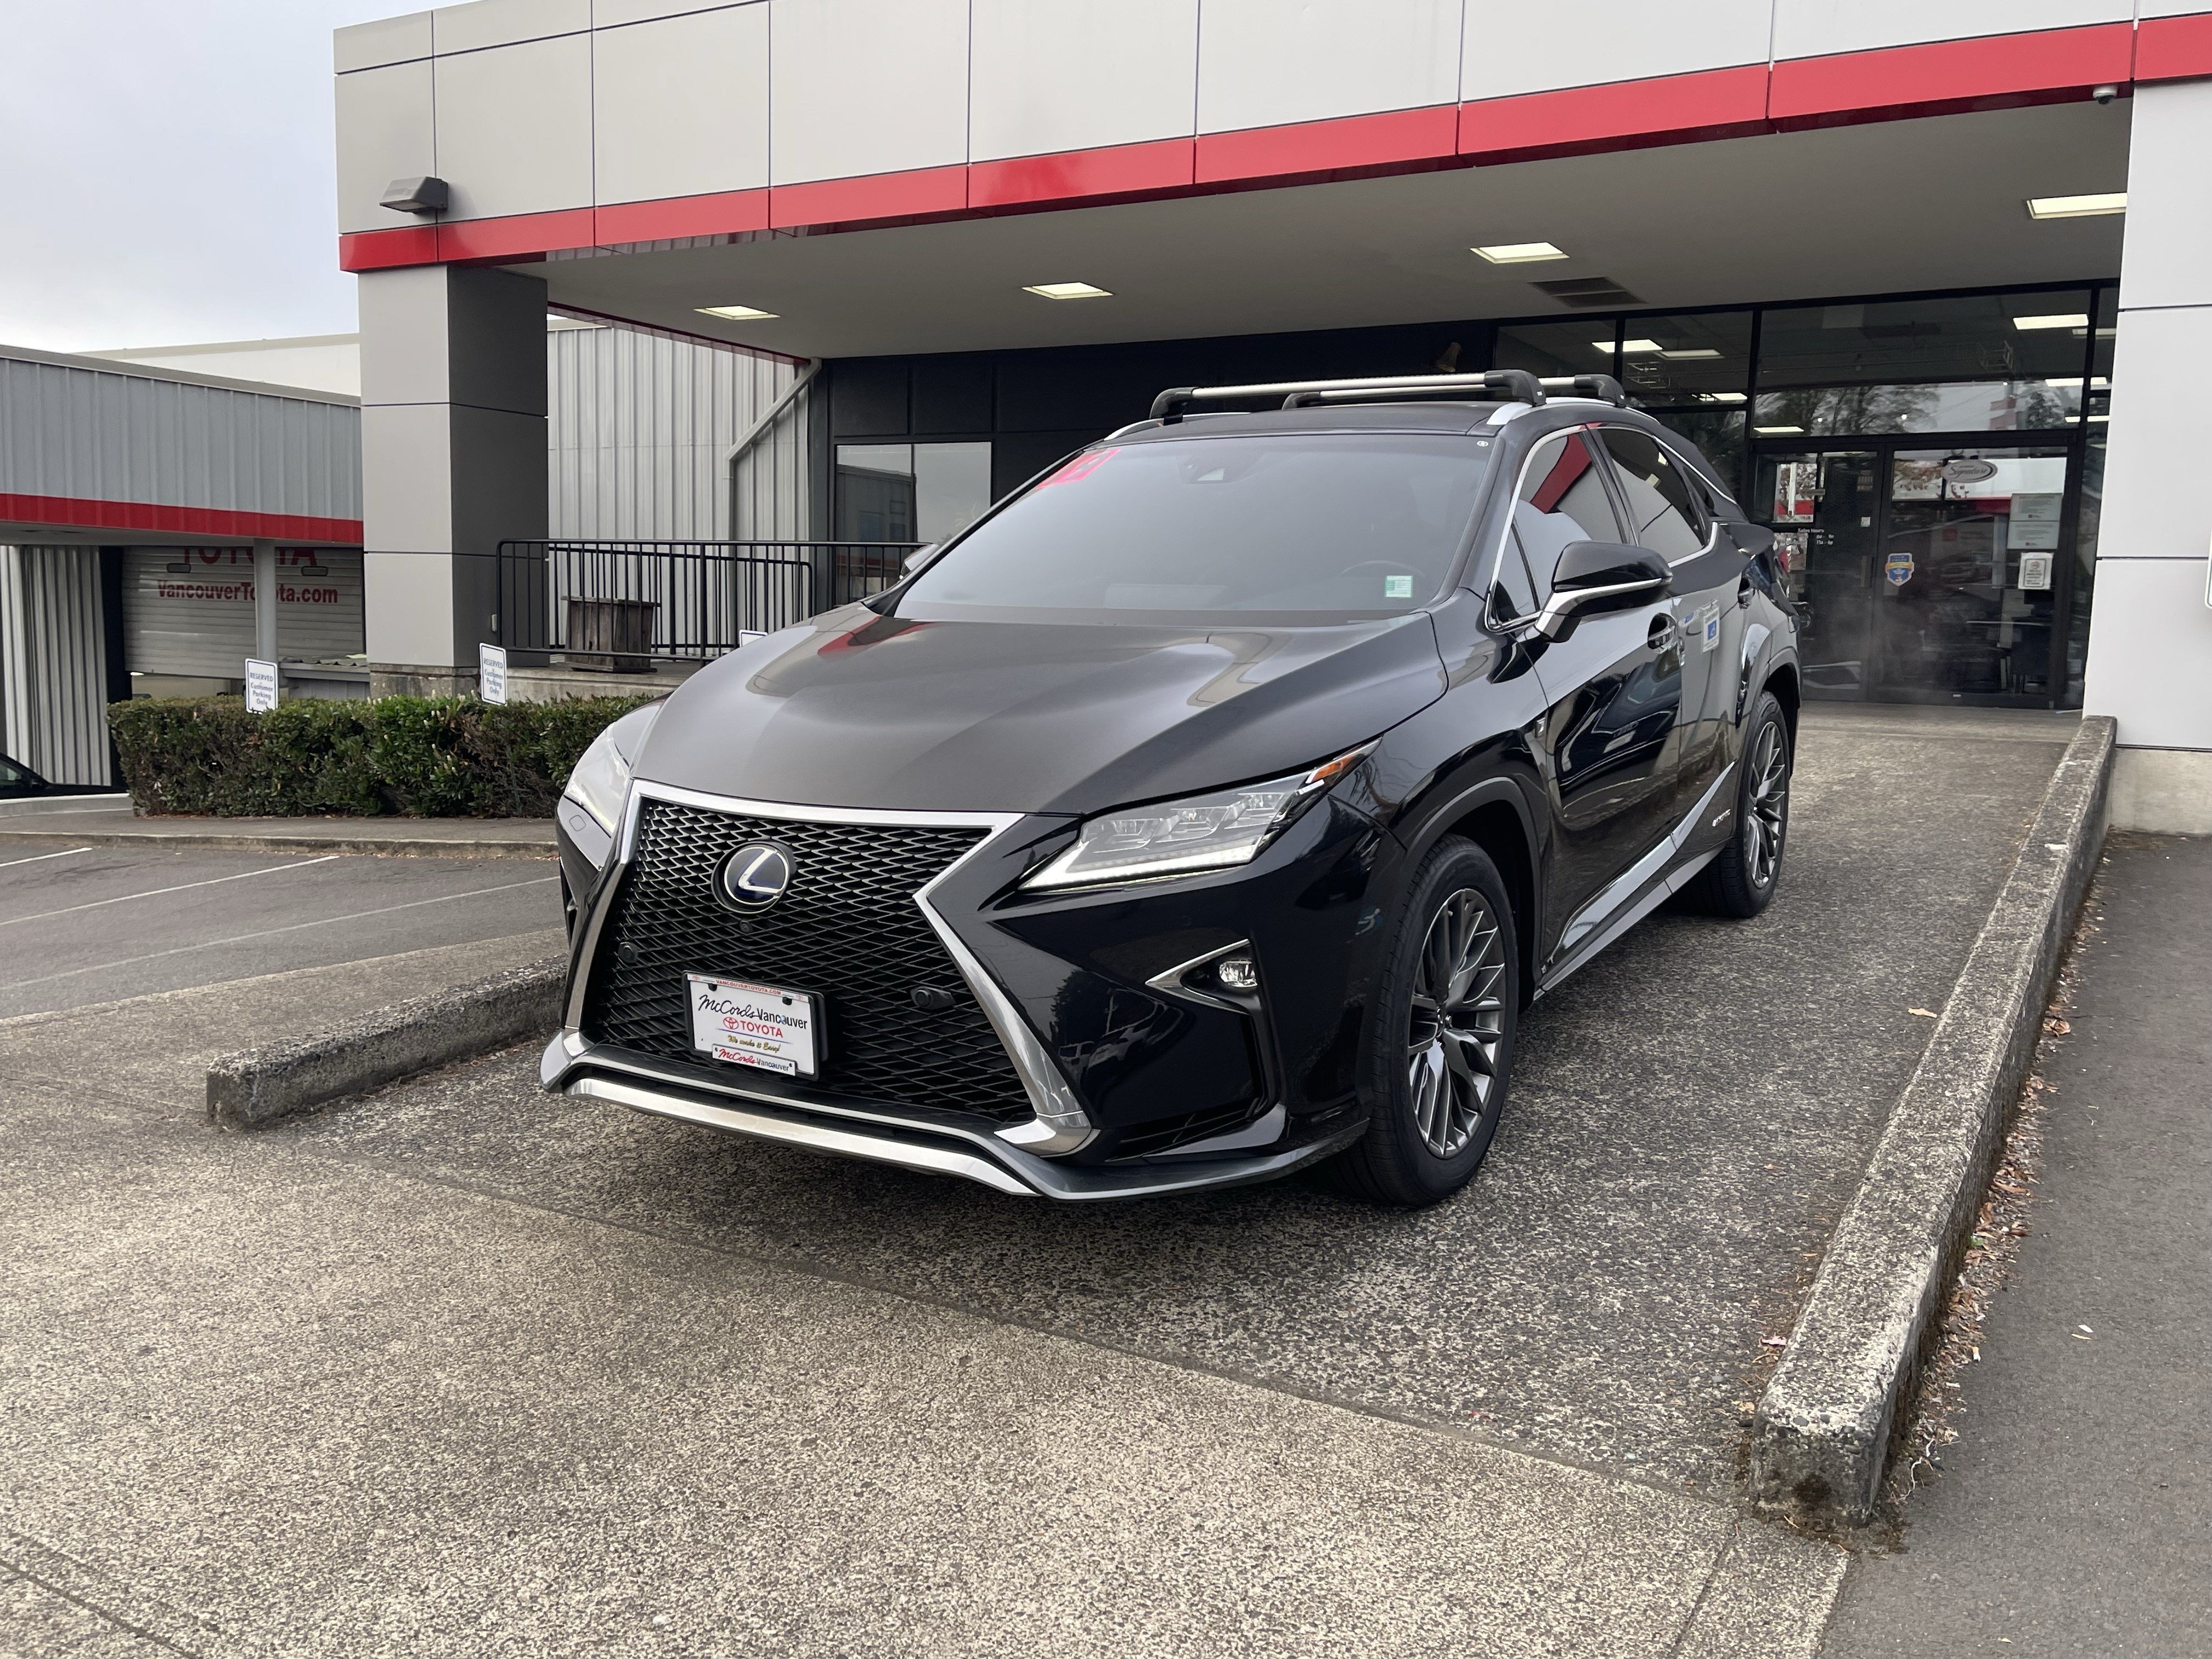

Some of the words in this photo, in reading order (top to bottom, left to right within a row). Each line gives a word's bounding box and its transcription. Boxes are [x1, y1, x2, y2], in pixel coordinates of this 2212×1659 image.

[484, 658, 504, 669] RESERVED
[250, 672, 273, 681] RESERVED
[251, 682, 273, 691] Customer
[487, 678, 502, 689] Parking
[253, 690, 271, 701] Parking
[490, 686, 499, 695] Only
[256, 698, 268, 707] Only
[715, 979, 781, 995] VANCOUVERTOYOTA.COM
[740, 1020, 783, 1038] TOYOTA
